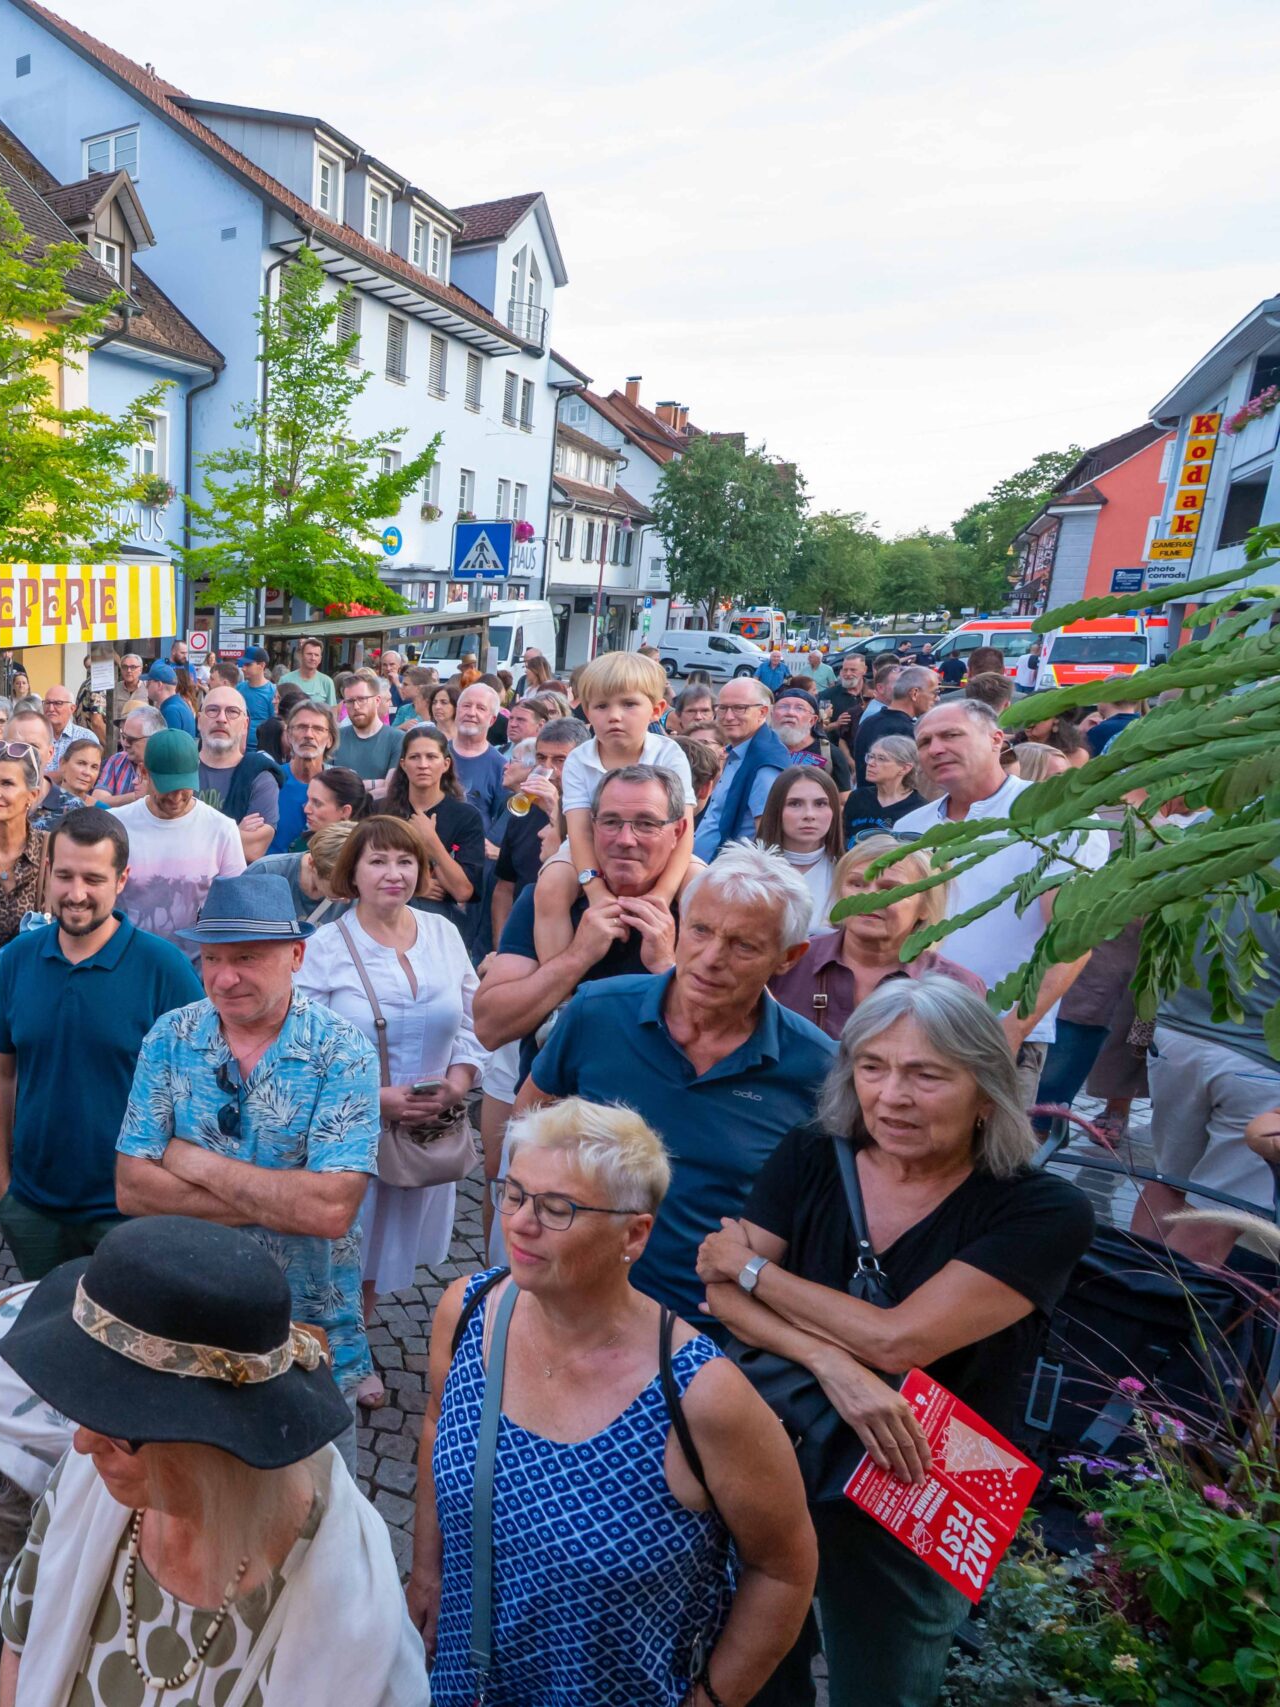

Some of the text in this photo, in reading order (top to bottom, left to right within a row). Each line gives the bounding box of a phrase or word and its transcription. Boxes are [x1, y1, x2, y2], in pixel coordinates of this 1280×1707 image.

[1175, 416, 1218, 533] Kodak
[511, 545, 537, 570] HAUS
[1152, 541, 1193, 549] CAMERAS
[732, 1089, 763, 1101] odlo
[910, 1478, 942, 1520] SOMMER
[936, 1500, 976, 1572] FEST
[960, 1517, 996, 1590] JAZZ
